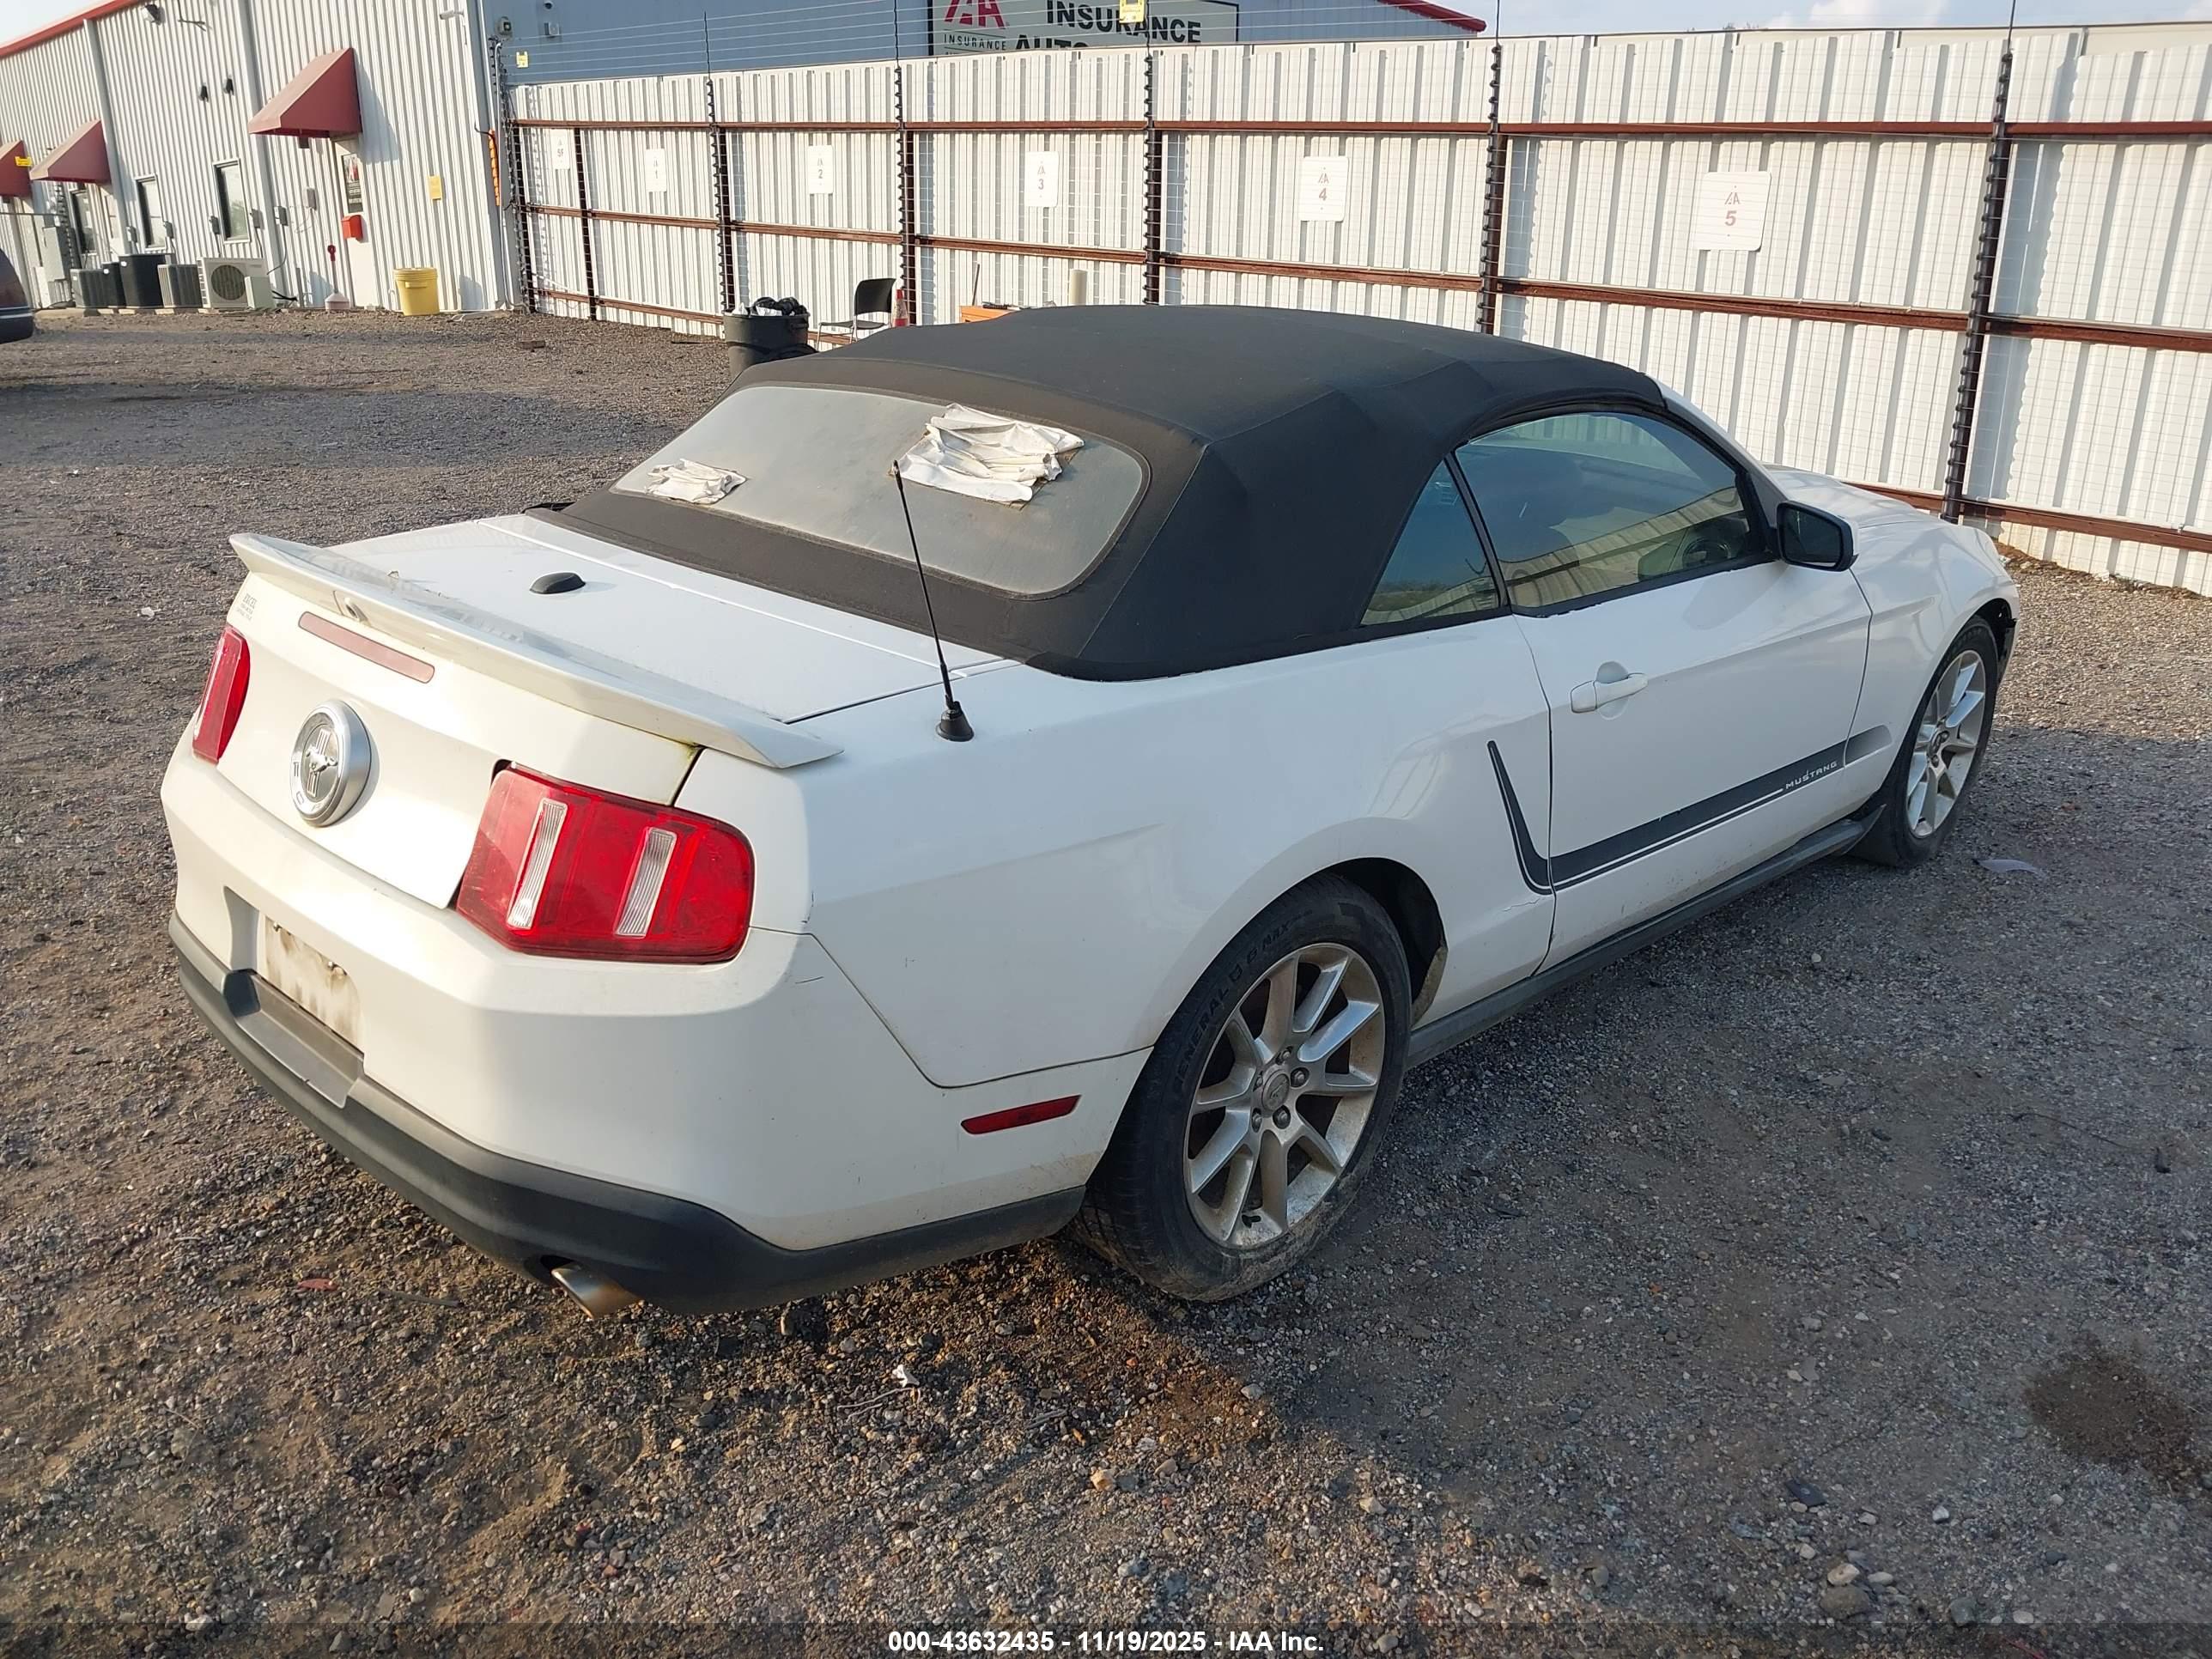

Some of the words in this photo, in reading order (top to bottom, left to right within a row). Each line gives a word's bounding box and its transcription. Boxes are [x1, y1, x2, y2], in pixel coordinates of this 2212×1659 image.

[945, 33, 1006, 51] INSURANCE
[817, 169, 823, 179] 2
[1037, 178, 1045, 190] 3
[1318, 187, 1328, 201] 4
[1724, 210, 1737, 227] 5
[1785, 761, 1838, 789] MUSTANG
